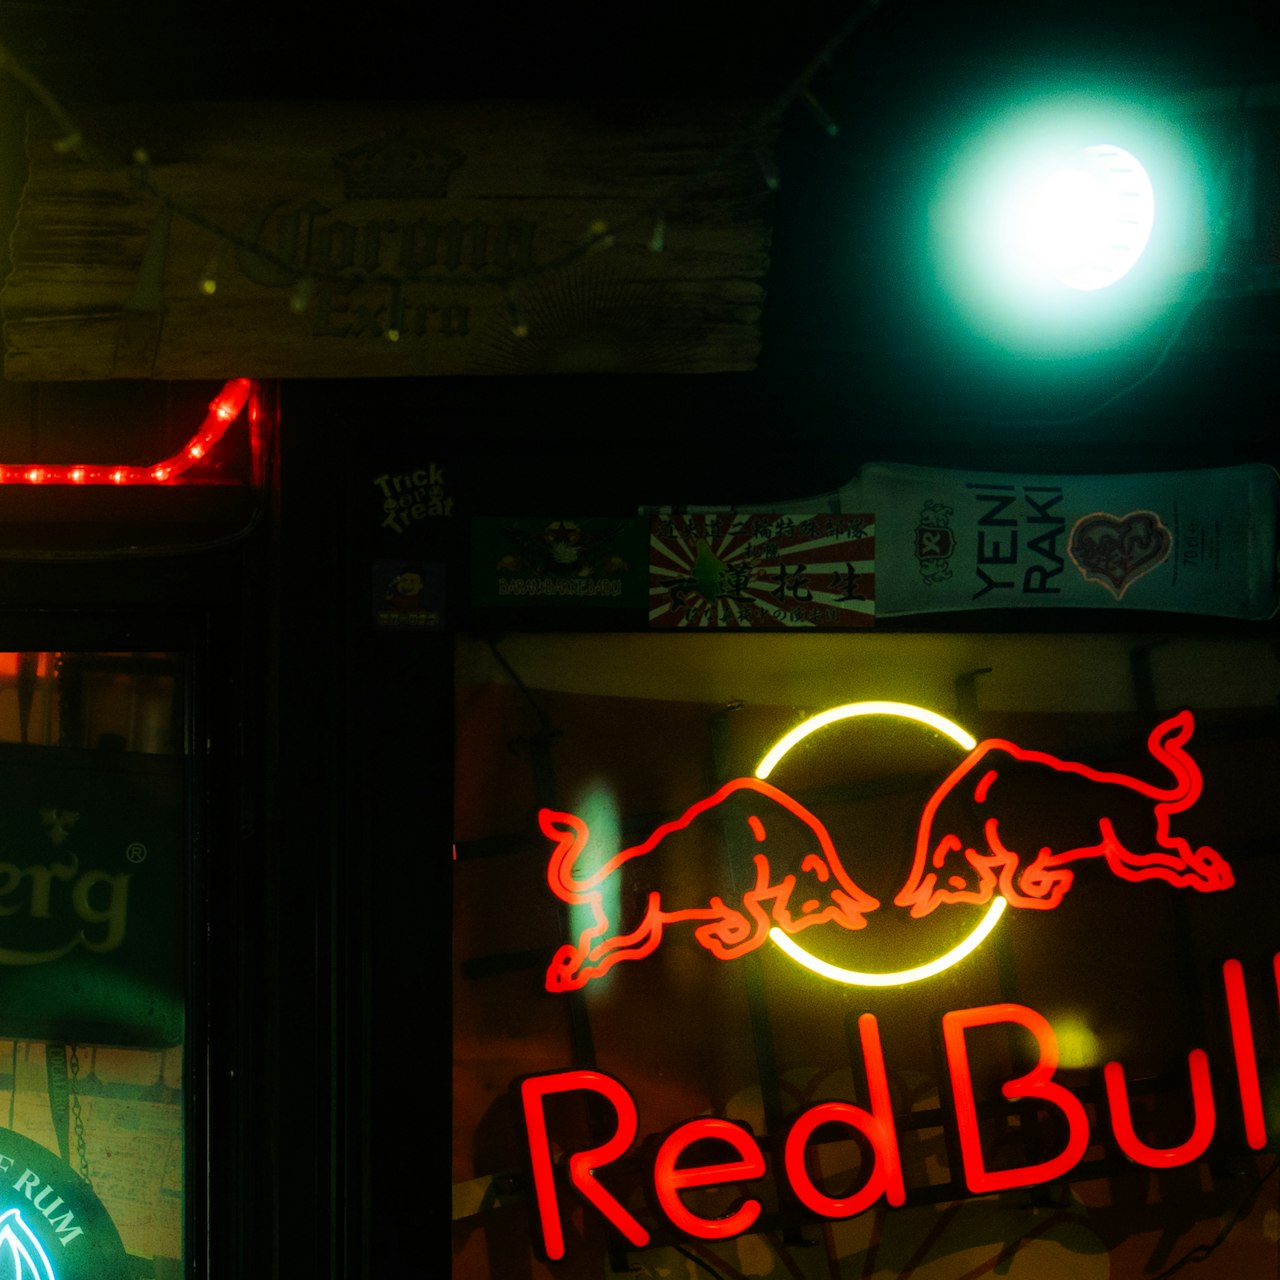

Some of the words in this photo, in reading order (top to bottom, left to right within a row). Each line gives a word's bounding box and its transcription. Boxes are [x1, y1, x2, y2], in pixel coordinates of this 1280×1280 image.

[373, 461, 446, 498] Trick
[381, 497, 456, 535] Treat
[1022, 486, 1066, 594] RAKI
[520, 1012, 907, 1261] Red
[942, 950, 1280, 1197] Bul
[13, 1168, 85, 1247] RUM
